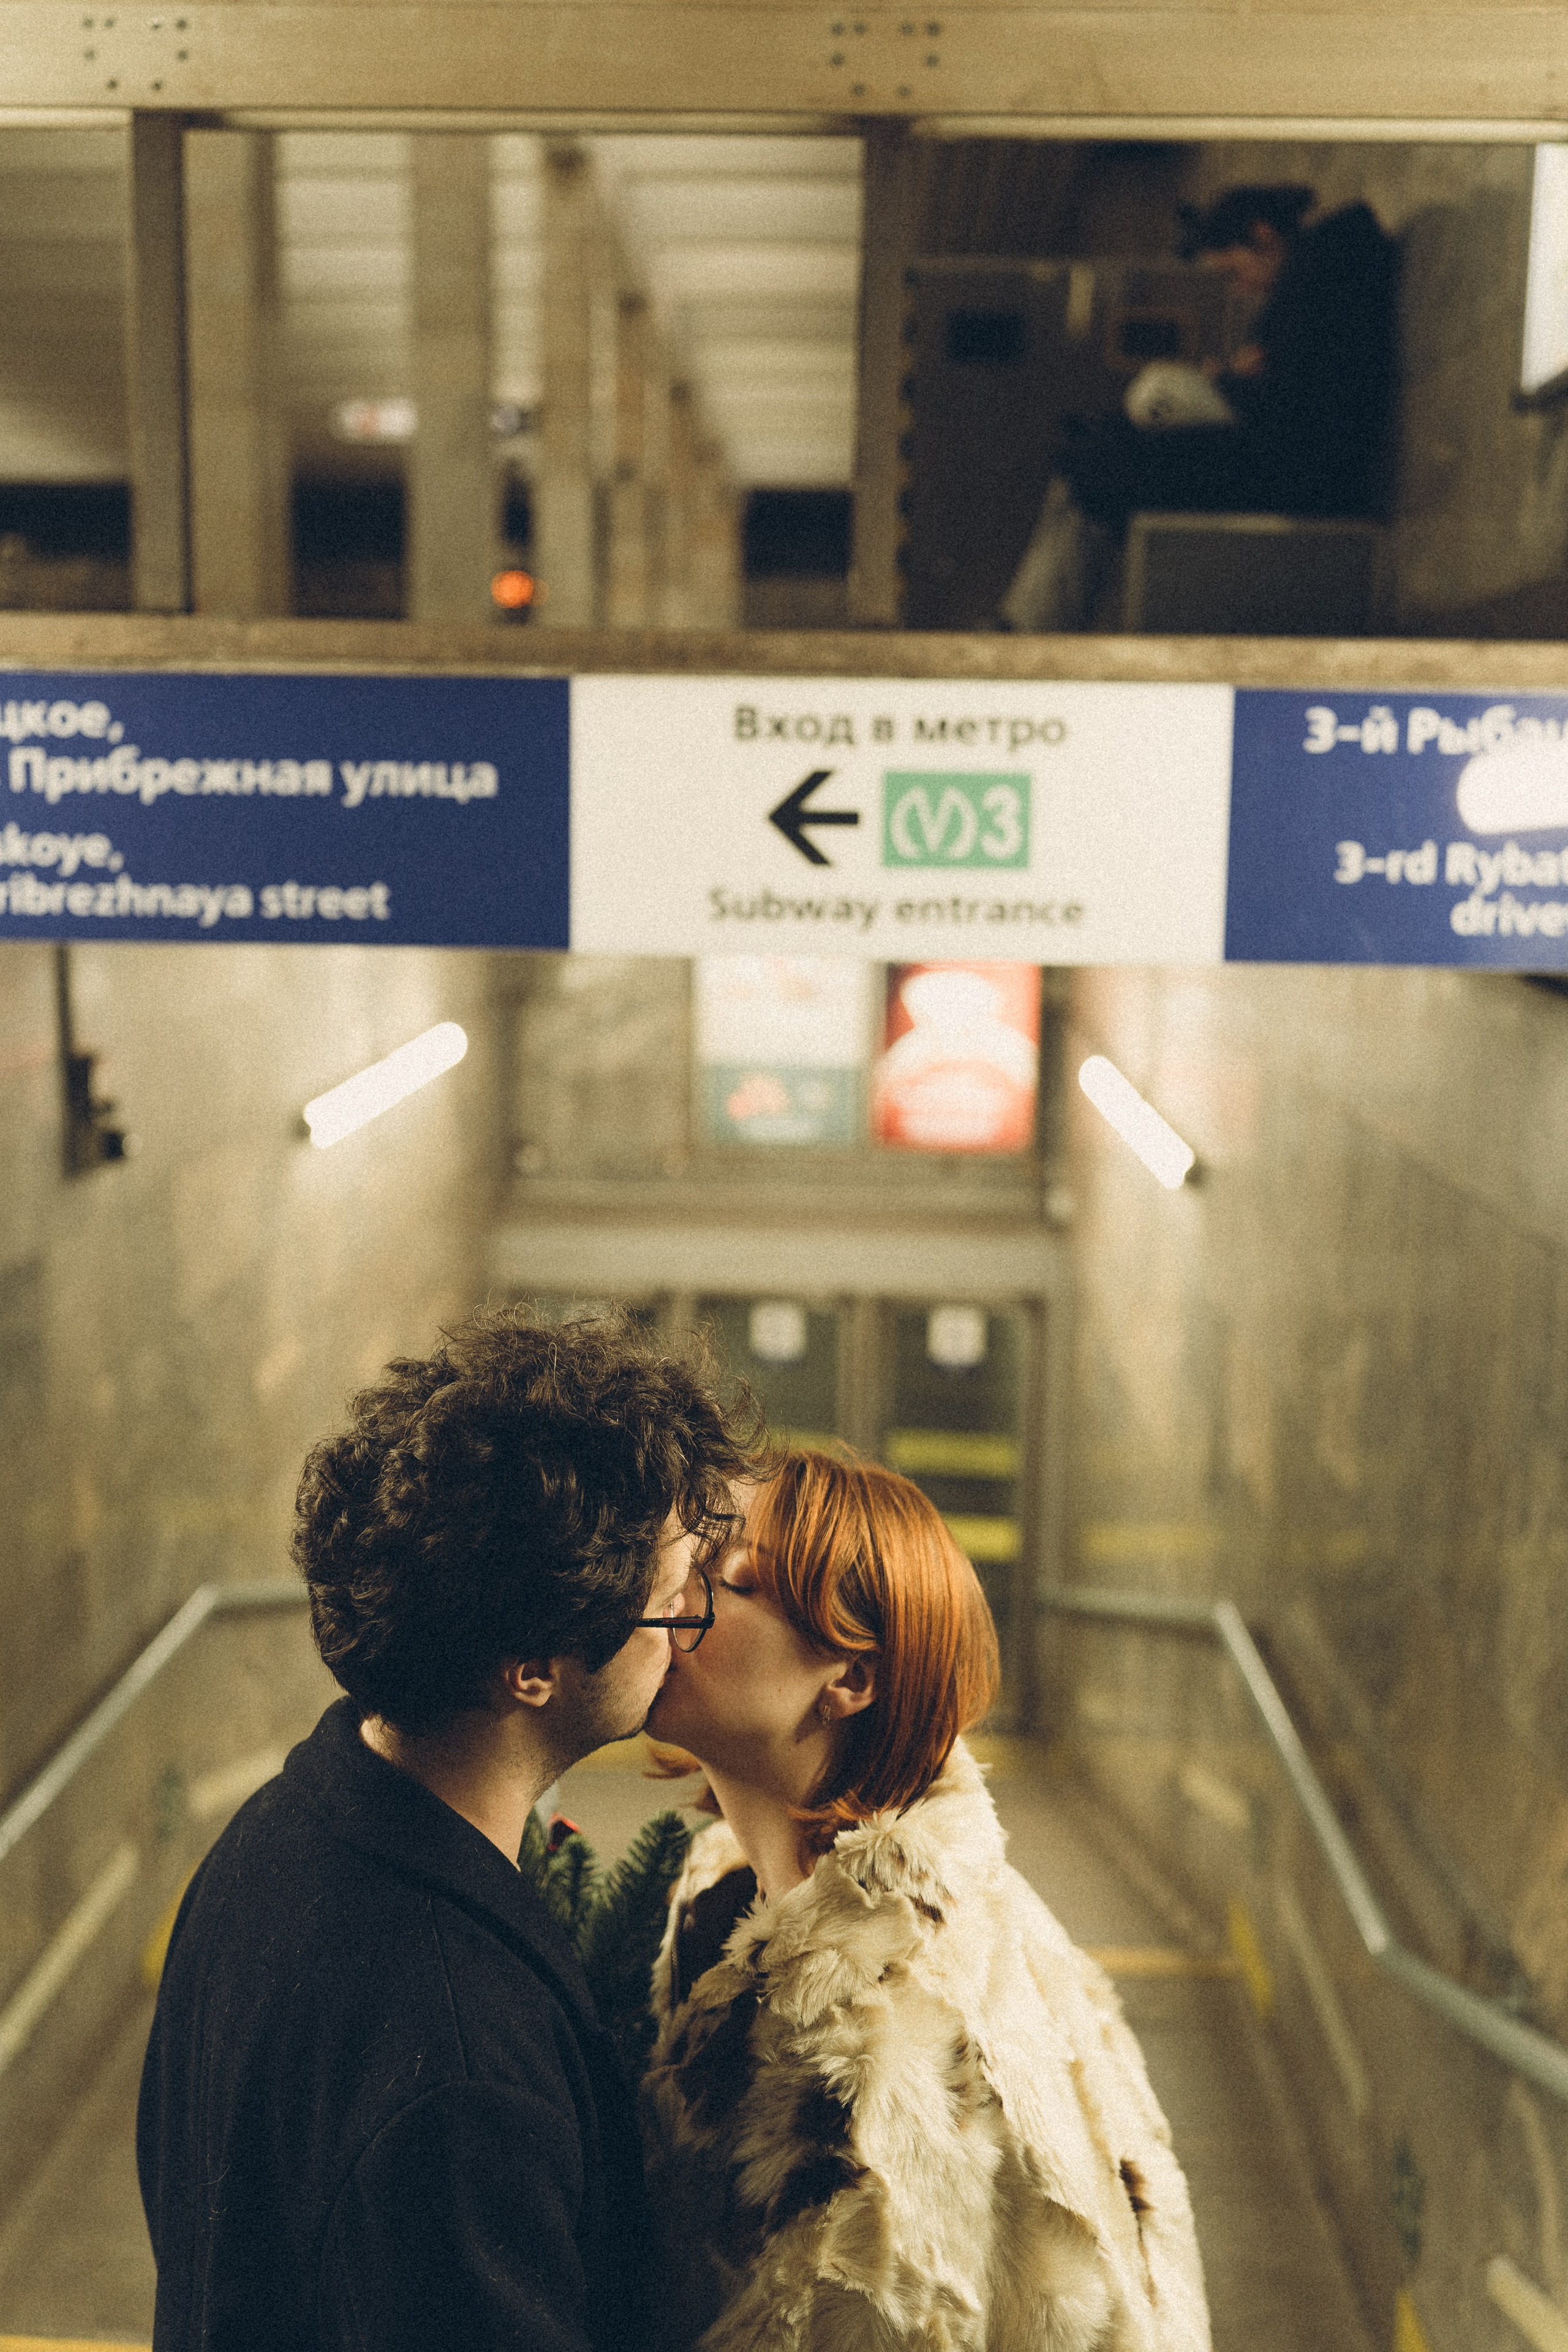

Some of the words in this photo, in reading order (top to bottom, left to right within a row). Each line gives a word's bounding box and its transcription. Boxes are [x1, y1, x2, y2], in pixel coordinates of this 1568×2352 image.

[735, 703, 854, 747] Вход
[870, 714, 895, 744] в
[914, 714, 1068, 753] метро
[1302, 705, 1399, 754] 3-й
[8, 744, 334, 804] Прибрежная
[339, 760, 499, 808] улица
[0, 821, 124, 877] koye,
[1333, 839, 1439, 884] 3-rd
[260, 880, 391, 921] street
[708, 884, 880, 933] Subway
[895, 892, 1085, 927] entrance
[1450, 891, 1568, 938] drive
